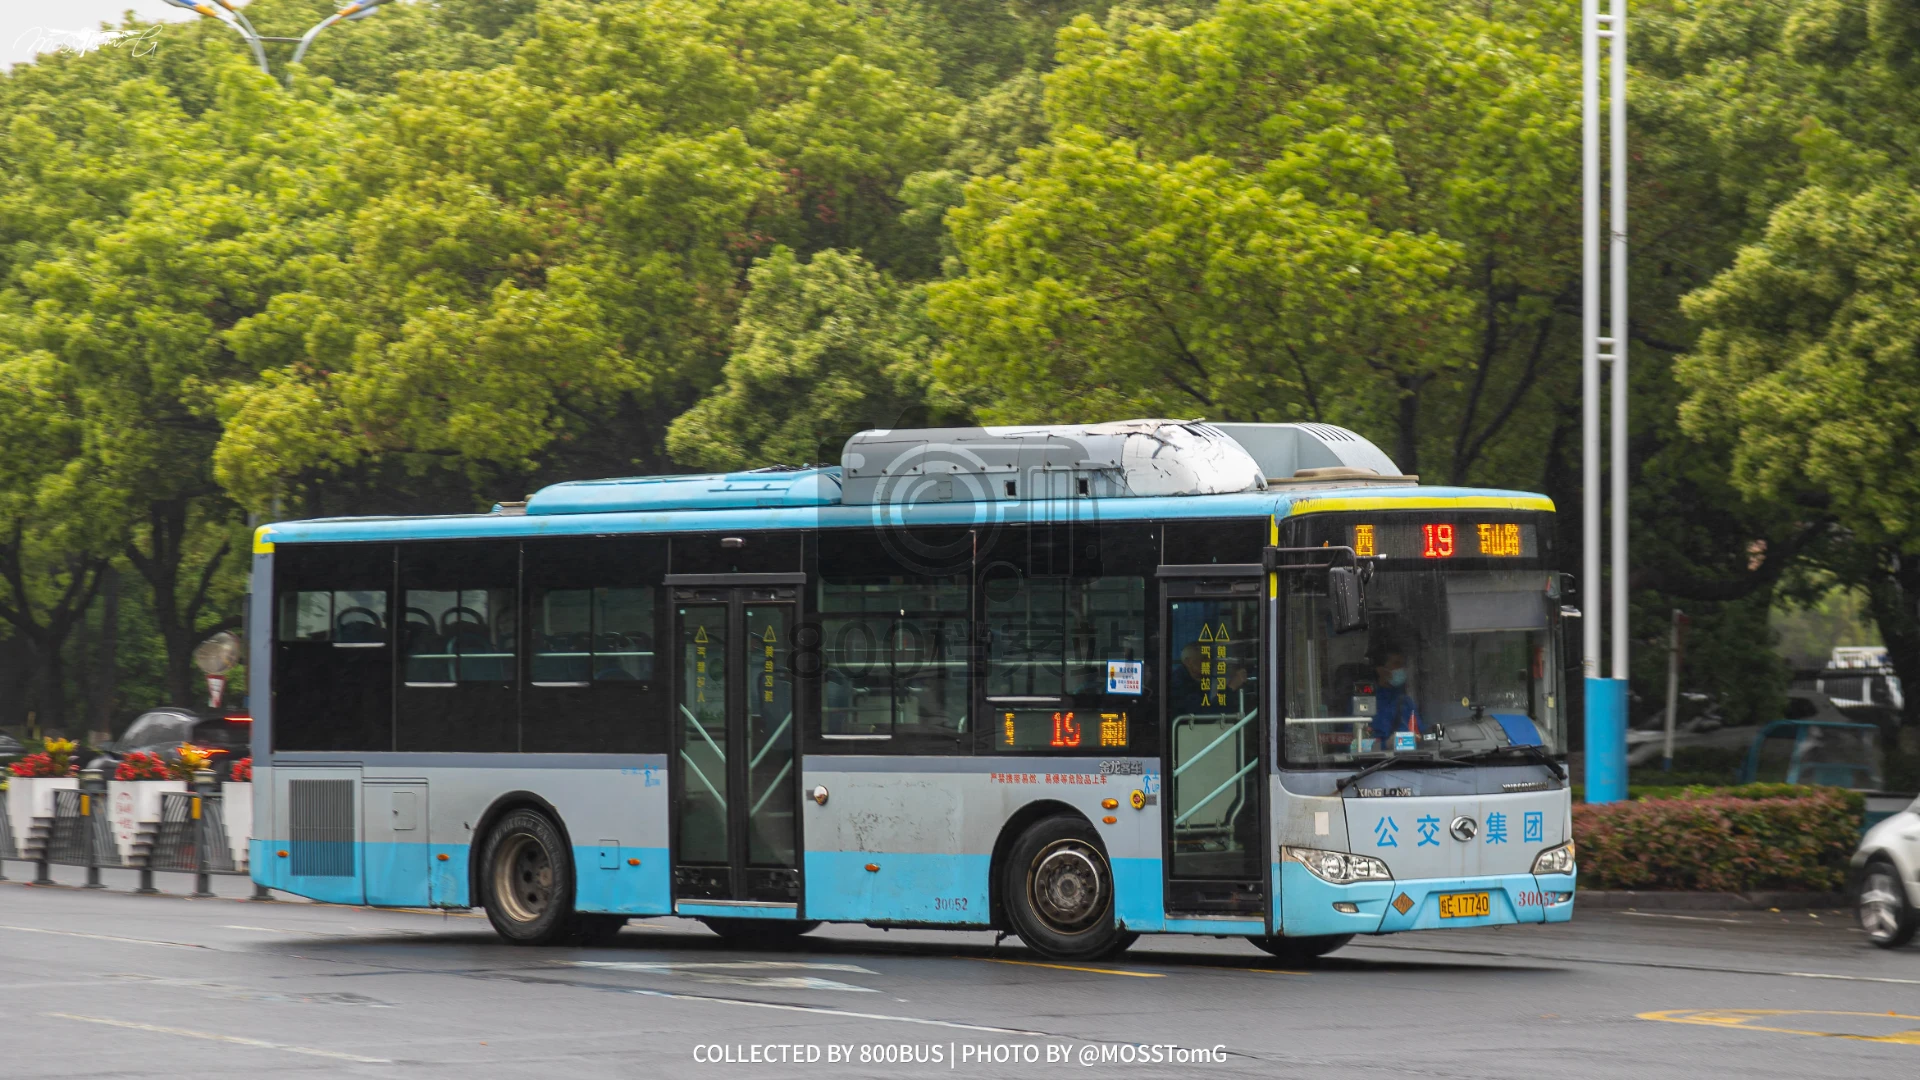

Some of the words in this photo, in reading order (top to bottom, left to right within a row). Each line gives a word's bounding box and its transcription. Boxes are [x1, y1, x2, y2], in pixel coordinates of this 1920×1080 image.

[1423, 524, 1454, 557] 19
[1052, 712, 1081, 746] 19
[934, 897, 968, 911] 30052
[1518, 891, 1557, 907] 30052
